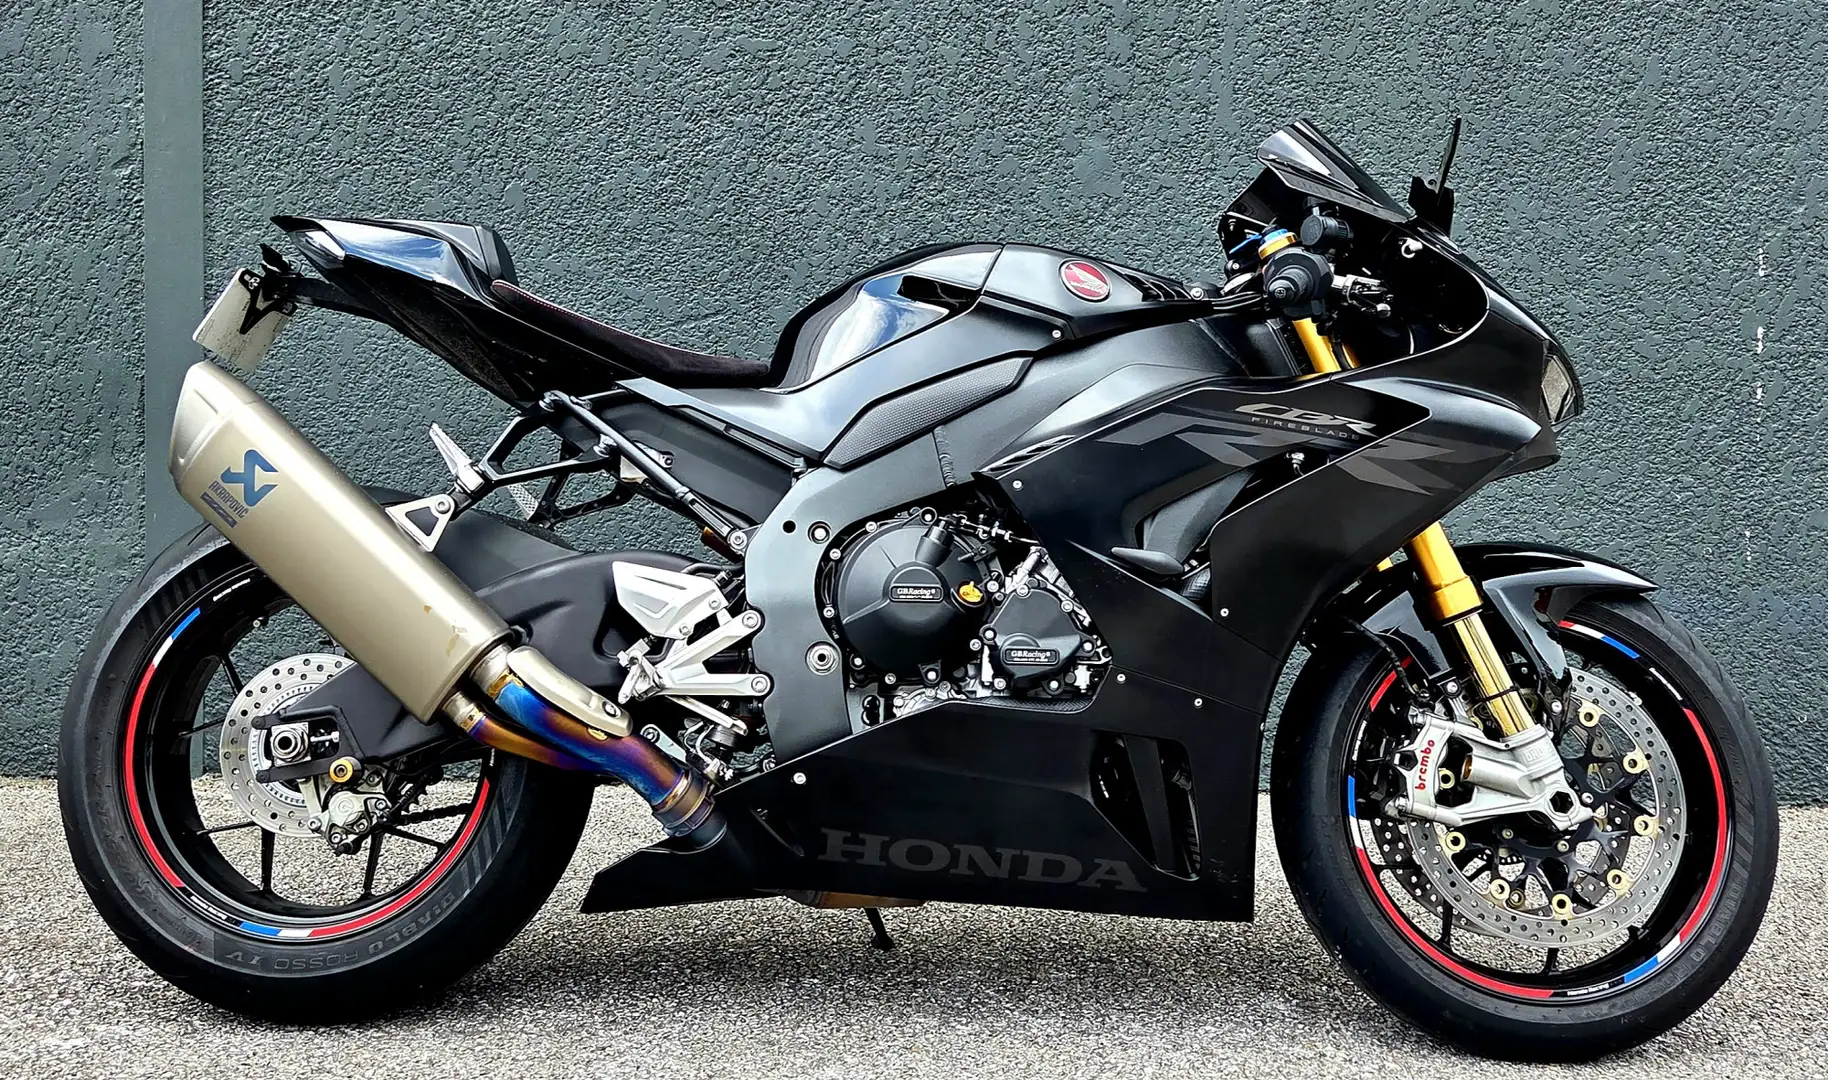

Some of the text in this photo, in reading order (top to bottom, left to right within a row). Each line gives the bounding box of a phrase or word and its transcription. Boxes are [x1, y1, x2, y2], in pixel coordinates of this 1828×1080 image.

[1235, 403, 1379, 438] CBR
[1251, 416, 1360, 441] FIREBLADE
[1415, 739, 1435, 791] brembo
[817, 827, 1148, 893] HONDA
[273, 951, 359, 971] ROSSO
